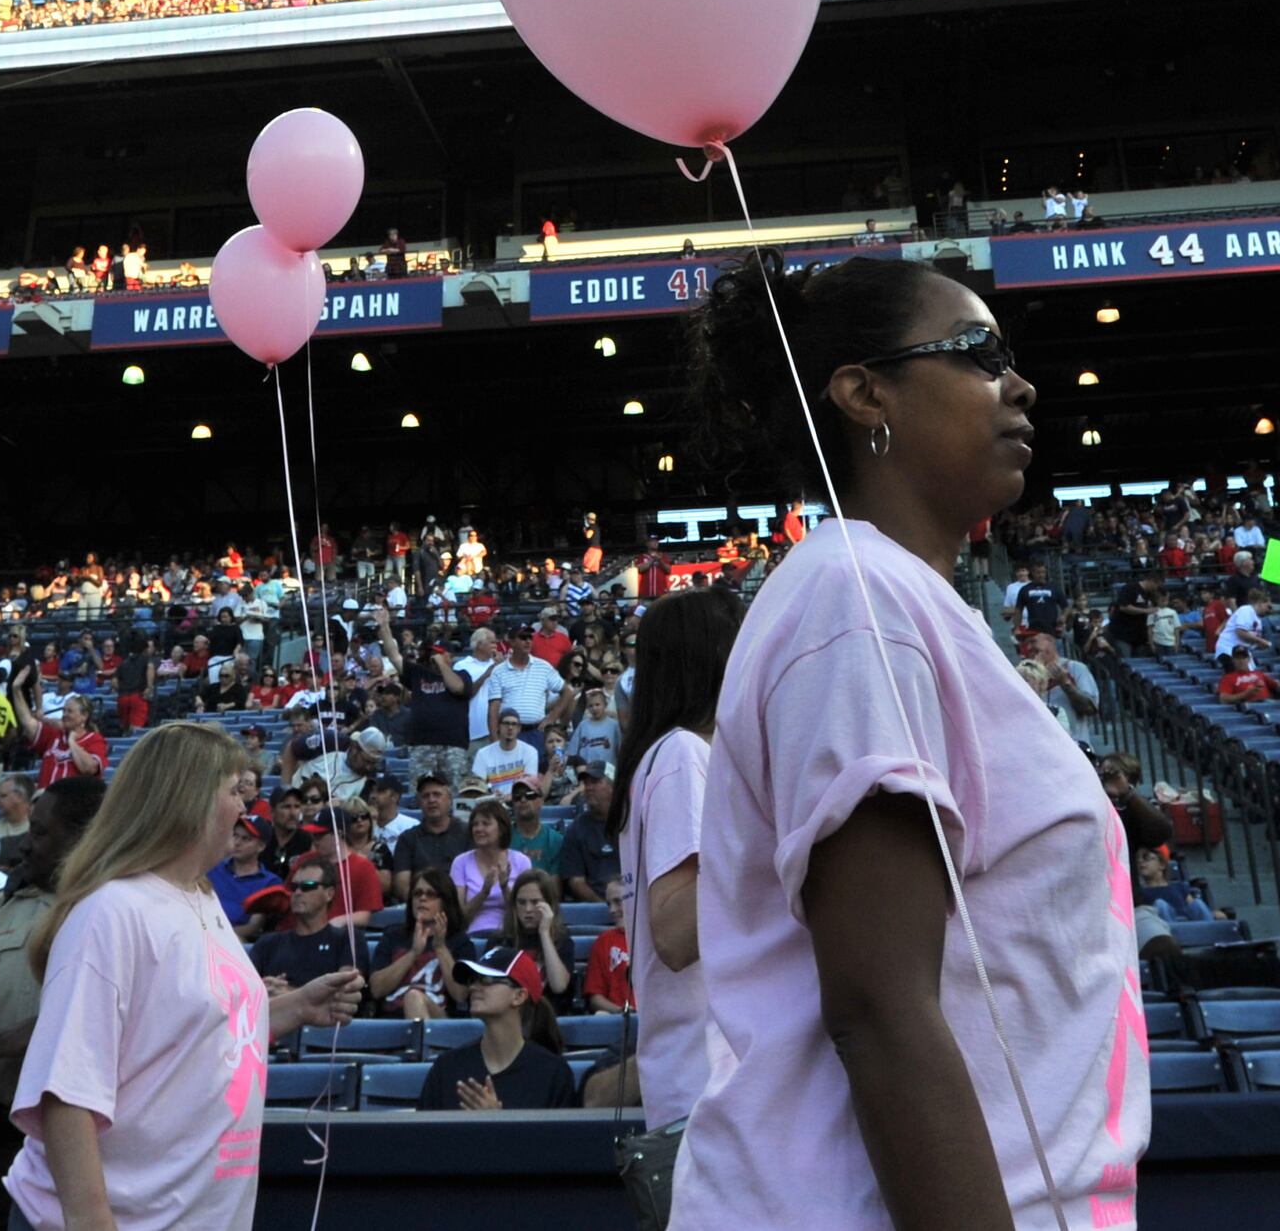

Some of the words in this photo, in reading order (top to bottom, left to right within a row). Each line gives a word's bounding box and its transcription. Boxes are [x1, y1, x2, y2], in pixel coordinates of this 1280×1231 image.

[1052, 241, 1126, 270] HANK
[1148, 233, 1205, 266] 44
[570, 276, 645, 304] EDDIE
[668, 267, 708, 300] 41
[133, 306, 217, 332] WARRE
